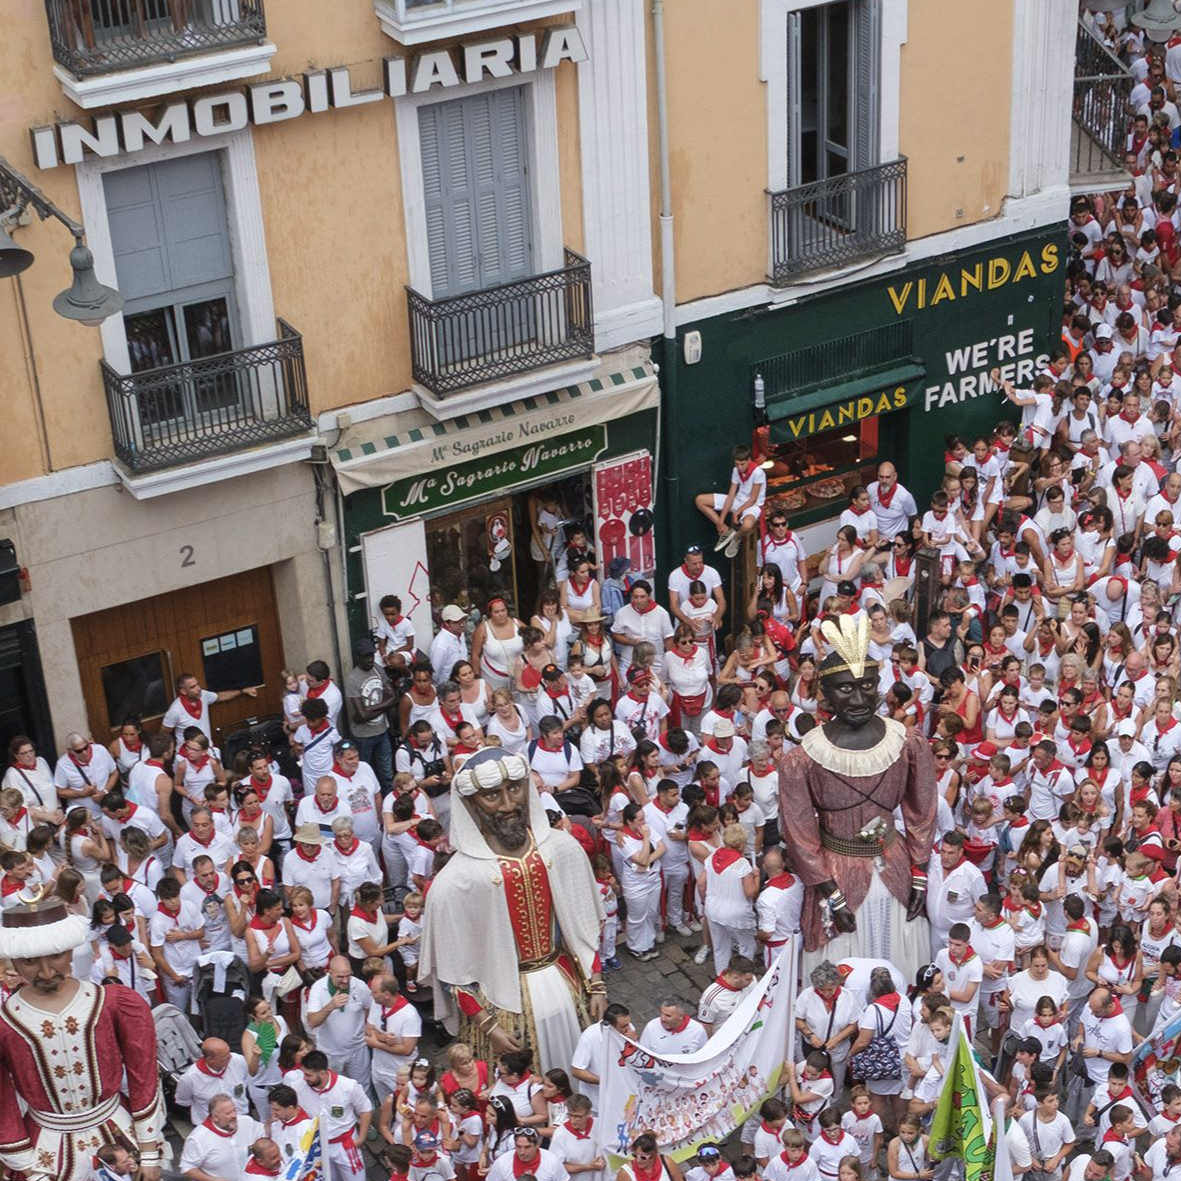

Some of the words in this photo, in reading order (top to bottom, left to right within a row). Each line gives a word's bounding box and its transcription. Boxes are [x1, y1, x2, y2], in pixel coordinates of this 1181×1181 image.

[30, 24, 589, 170] INMOBILIARIA
[888, 242, 1060, 314] VIANDAS
[945, 328, 1035, 376] WE'RE
[924, 353, 1050, 412] FARMERS
[453, 431, 514, 458] Sagrario
[519, 413, 575, 439] Navarro
[788, 387, 908, 438] VIANDAS
[440, 462, 517, 496] Sagrario
[520, 438, 594, 473] Navarro
[179, 545, 196, 568] 2
